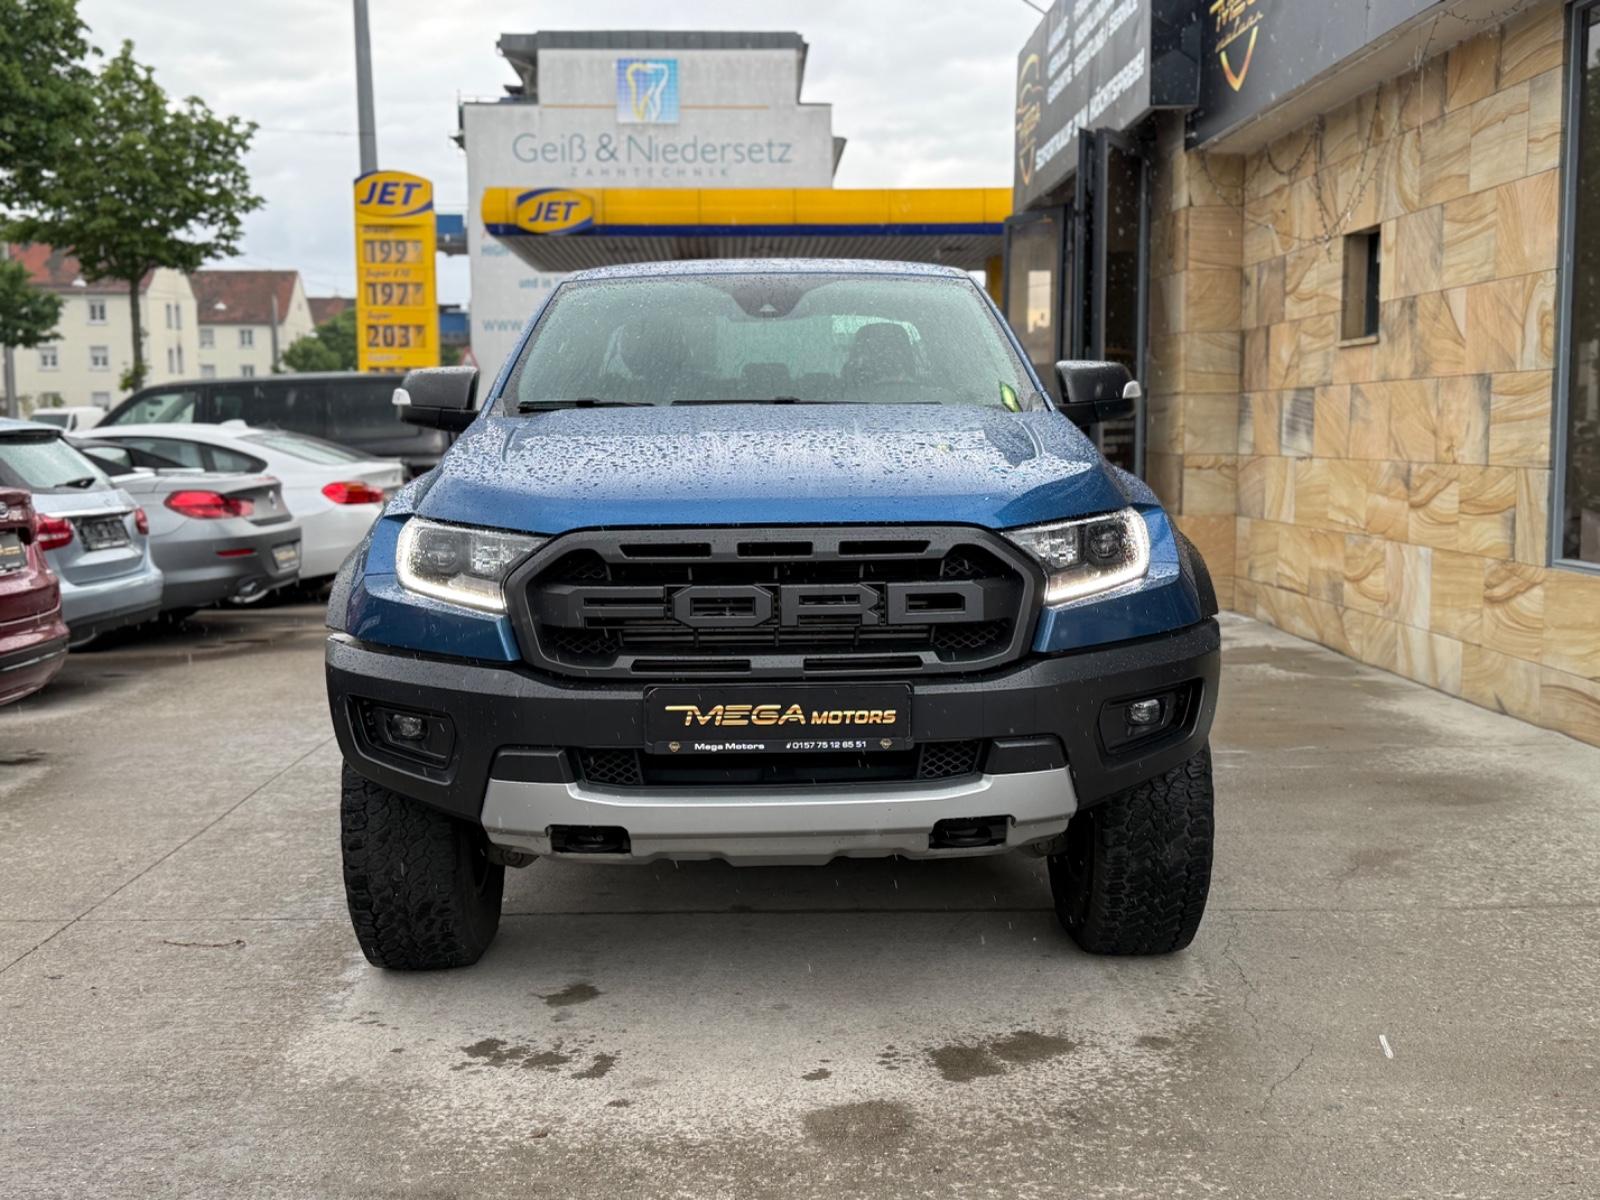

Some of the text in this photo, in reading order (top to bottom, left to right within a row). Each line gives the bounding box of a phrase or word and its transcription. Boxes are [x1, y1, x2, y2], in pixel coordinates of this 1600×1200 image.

[512, 133, 793, 164] Geiß & Niedersetz
[570, 167, 729, 177] ZAHNTECHNIK
[360, 181, 422, 206] JET
[529, 202, 578, 222] JET
[558, 583, 985, 628] FORD
[665, 704, 896, 726] MEGA MOTORS
[694, 742, 765, 752] Mega Motors
[792, 741, 815, 749] 0157
